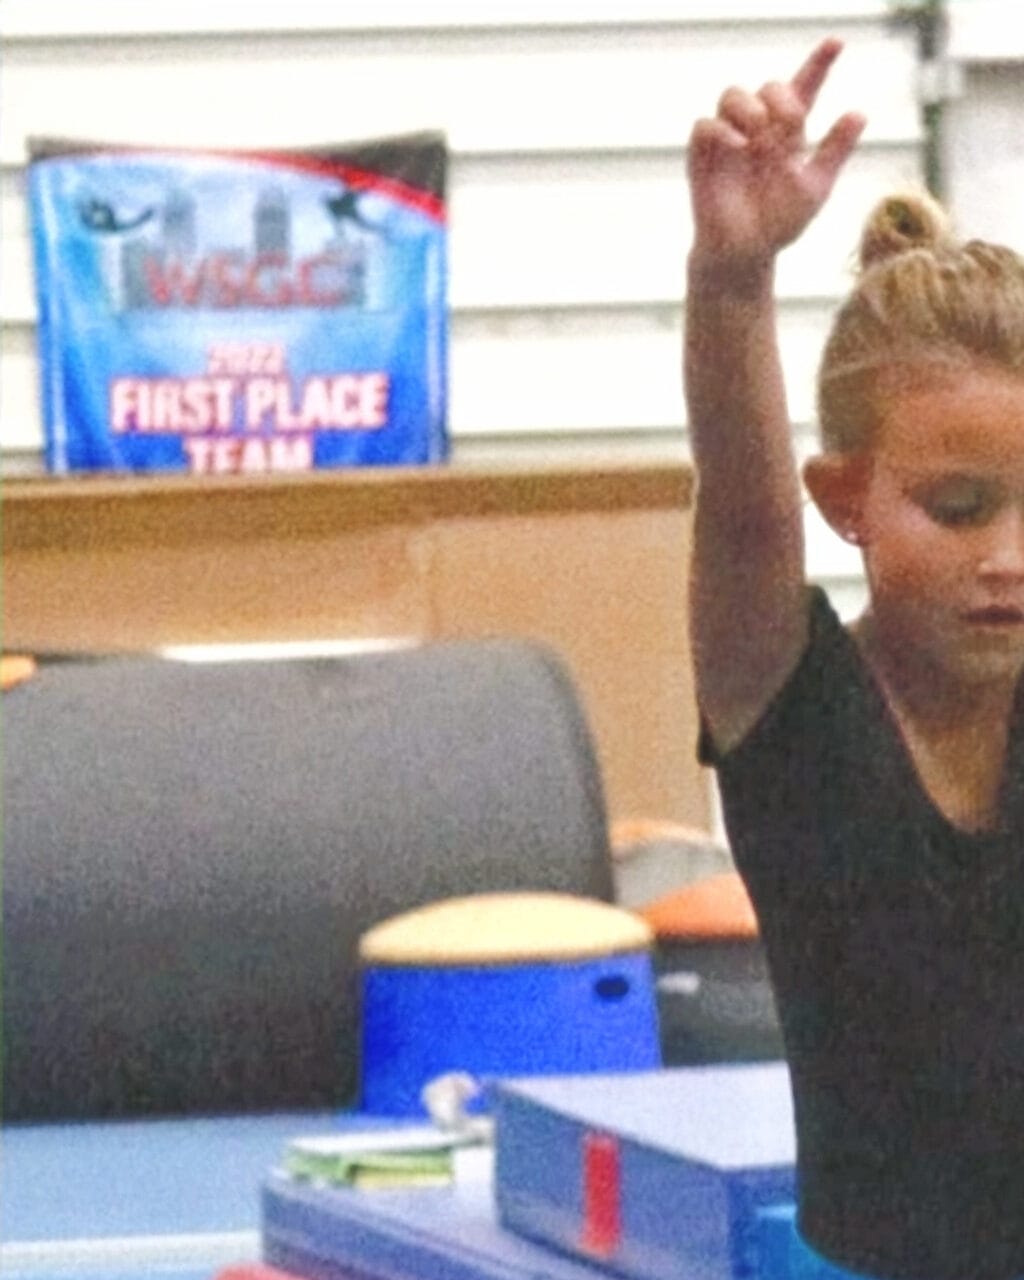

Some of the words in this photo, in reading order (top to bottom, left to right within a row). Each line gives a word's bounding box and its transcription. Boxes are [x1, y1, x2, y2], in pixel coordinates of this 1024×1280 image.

[110, 377, 236, 433] FIRST
[245, 372, 389, 432] PLACE
[184, 435, 313, 473] TEAM
